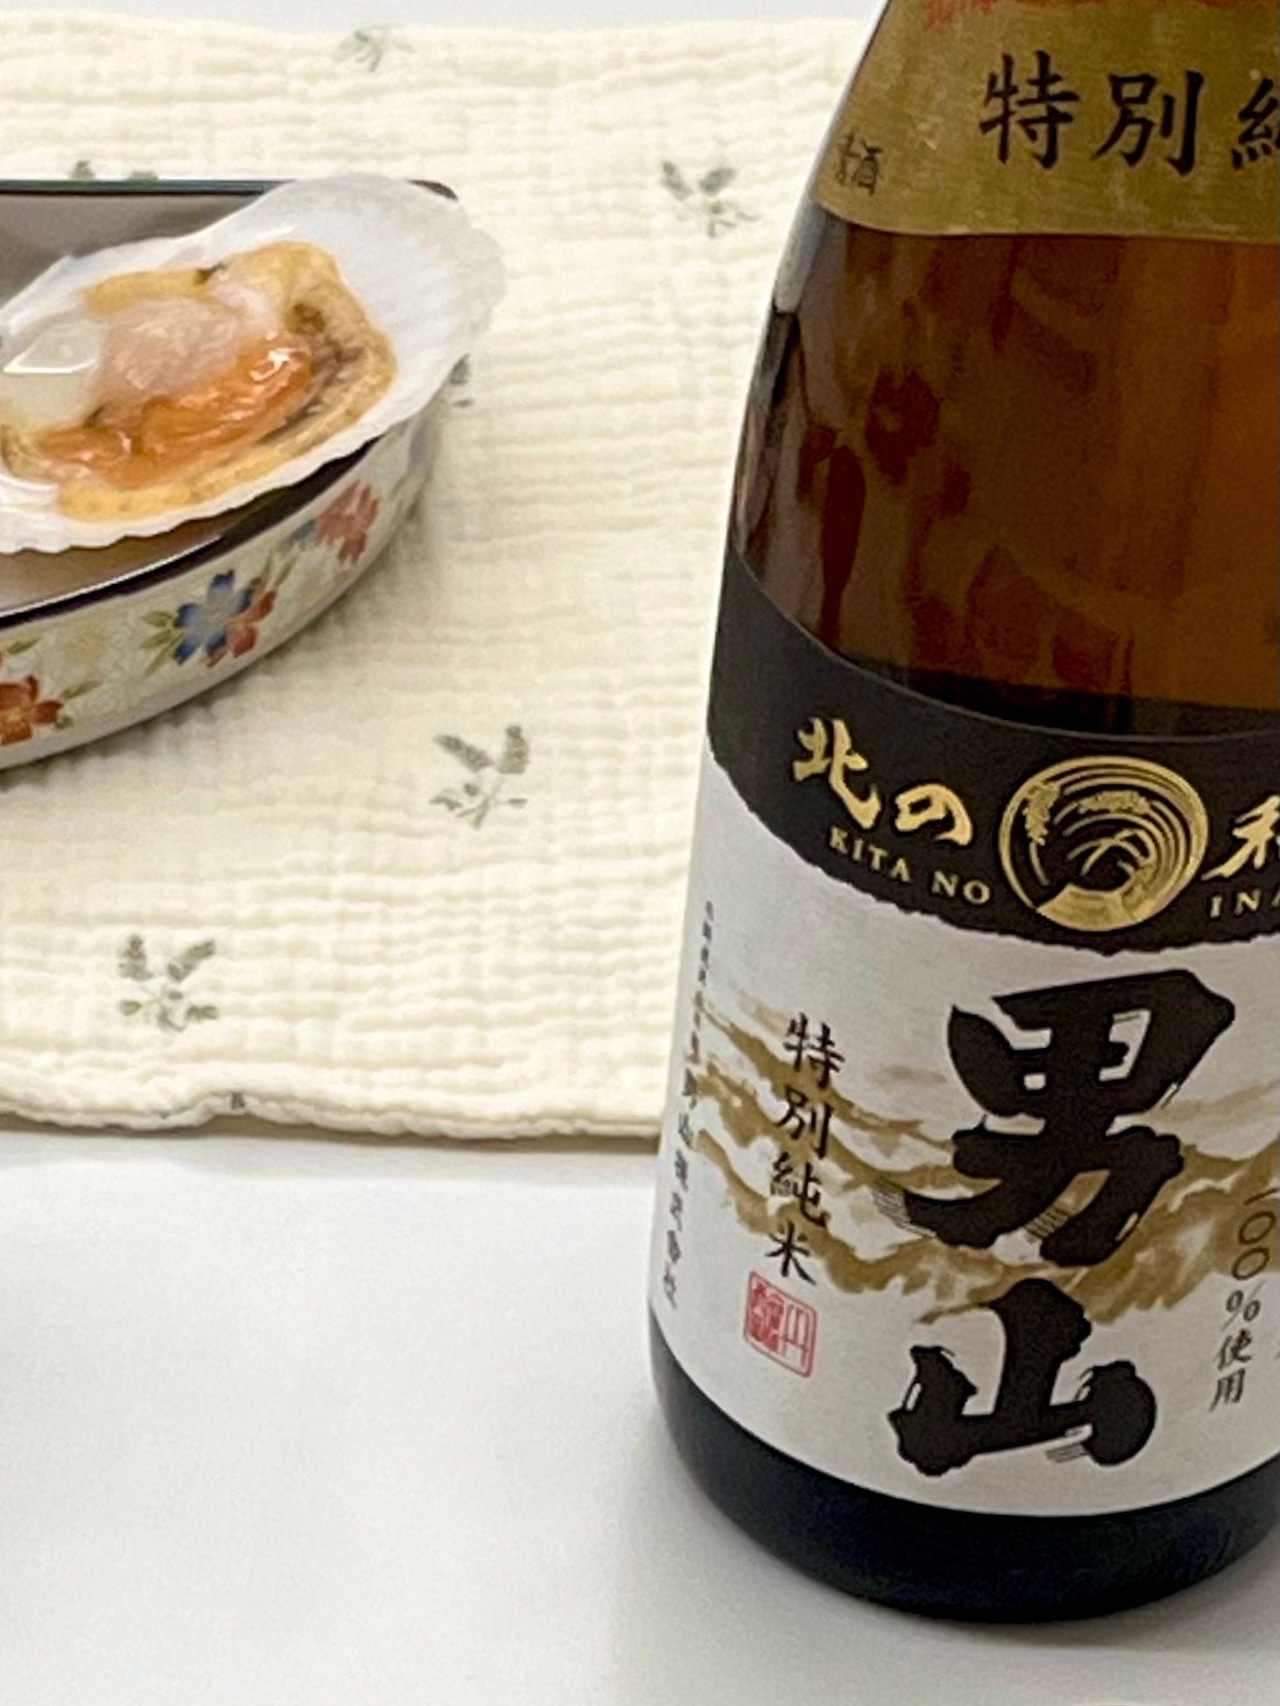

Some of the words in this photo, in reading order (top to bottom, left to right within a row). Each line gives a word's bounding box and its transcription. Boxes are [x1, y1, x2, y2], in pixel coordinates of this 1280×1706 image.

[792, 716, 973, 846] 北の
[829, 825, 911, 883] KITA
[931, 869, 991, 905] NO
[1210, 886, 1280, 918] IN
[764, 1011, 845, 1286] 特別純米
[880, 969, 1235, 1476] 男山
